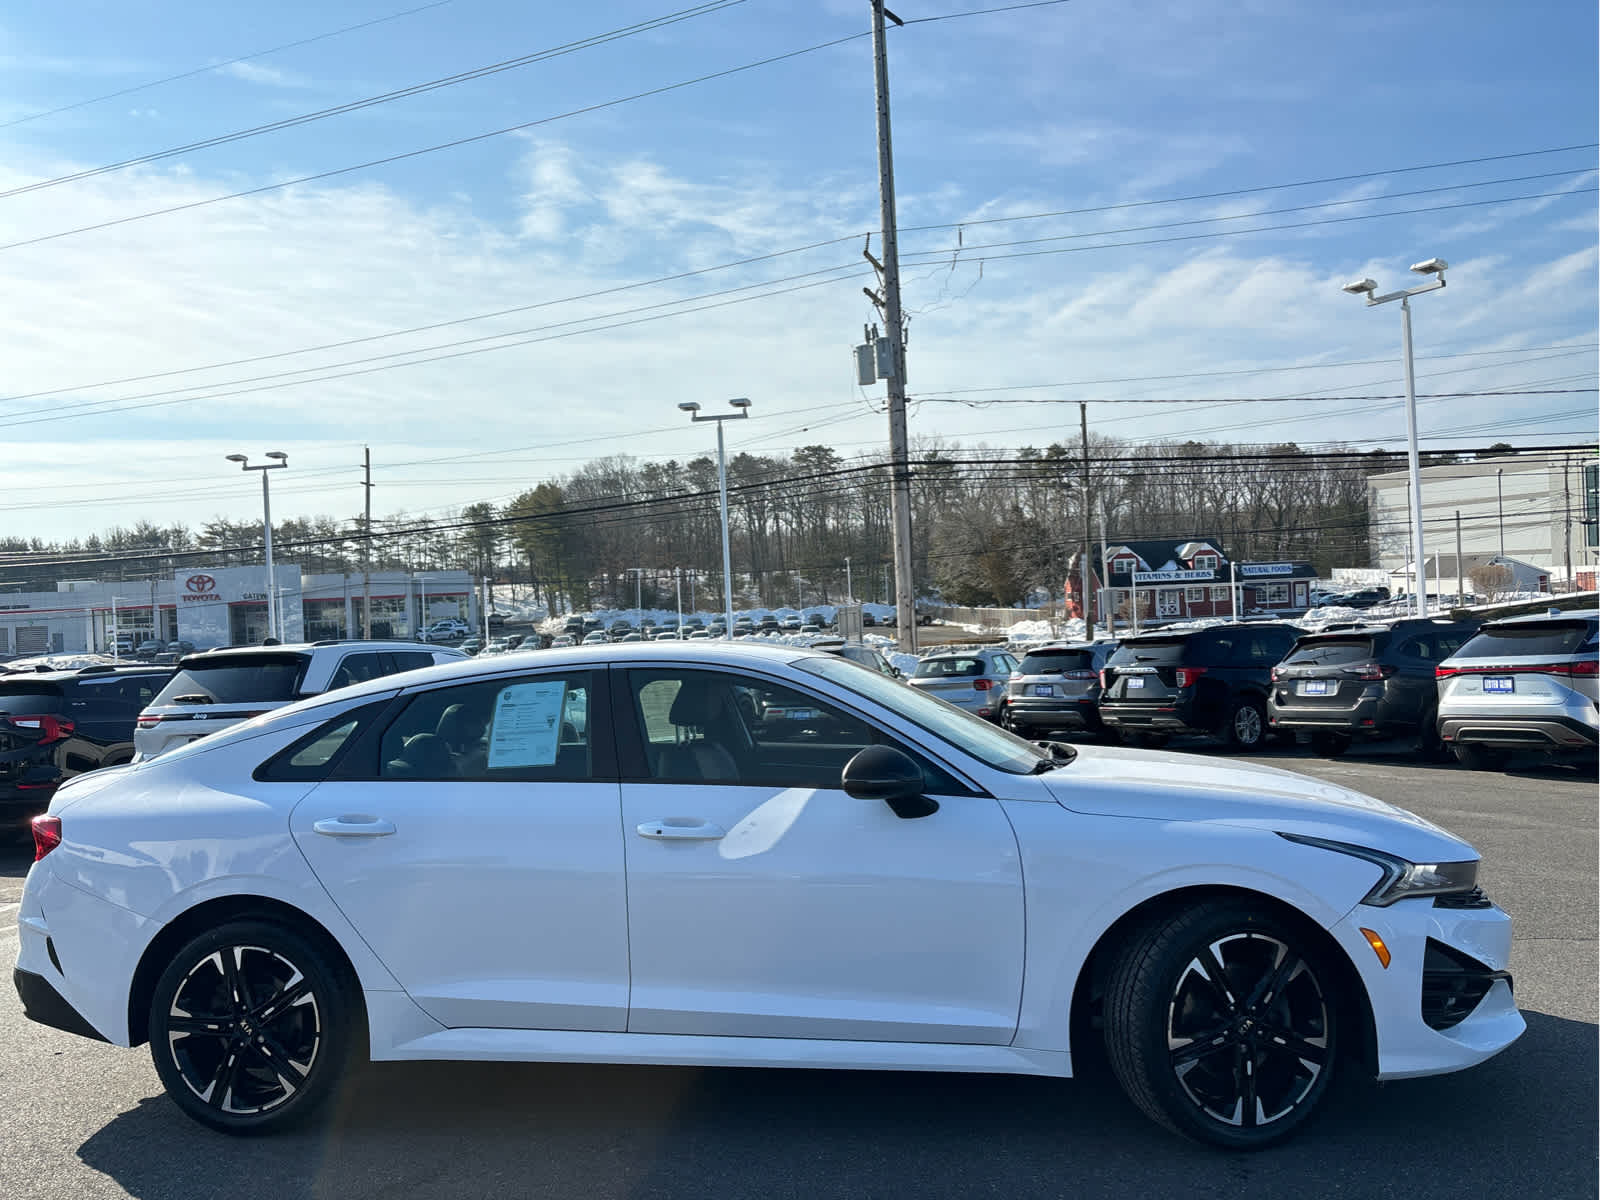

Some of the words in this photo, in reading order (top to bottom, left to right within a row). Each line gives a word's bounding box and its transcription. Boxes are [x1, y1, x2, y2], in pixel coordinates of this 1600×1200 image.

[1271, 565, 1292, 573] FOODS
[1134, 572, 1172, 581] VITAMINS
[181, 594, 222, 602] TOYOTA
